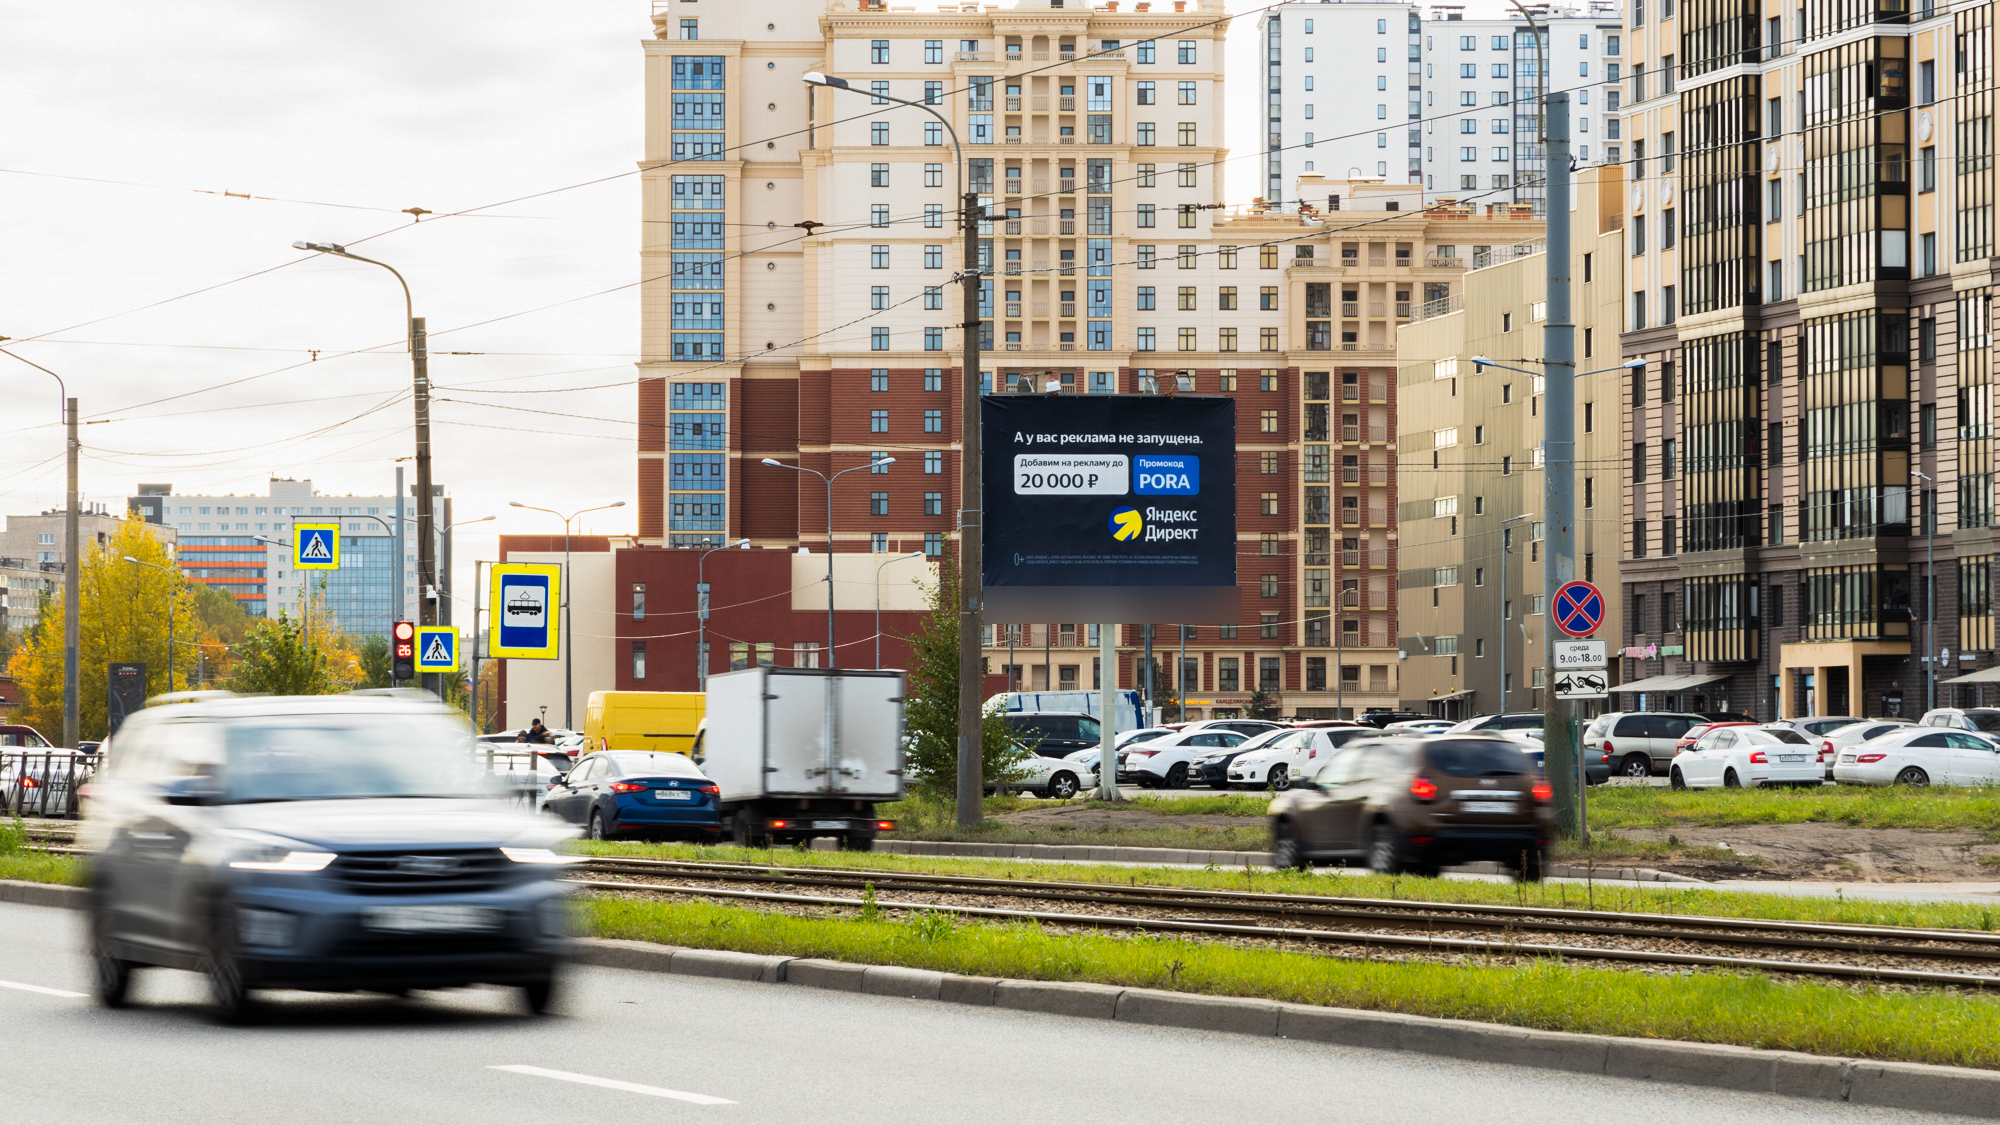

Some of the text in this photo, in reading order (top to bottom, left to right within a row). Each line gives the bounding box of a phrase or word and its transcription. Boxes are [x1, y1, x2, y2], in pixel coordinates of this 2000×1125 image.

[1014, 431, 1204, 447] А у вас реклама не запущена.
[1020, 458, 1060, 468] Добавим
[1073, 460, 1111, 469] рекламу
[1112, 460, 1124, 468] до
[1139, 458, 1185, 469] Промокод
[1139, 474, 1191, 490] PORA
[1145, 506, 1198, 524] Яндекс
[1145, 524, 1199, 542] Директ
[1013, 552, 1025, 566] 0+
[398, 644, 412, 657] 26
[1569, 645, 1590, 653] среда
[1560, 653, 1602, 664] 9.00-18.00
